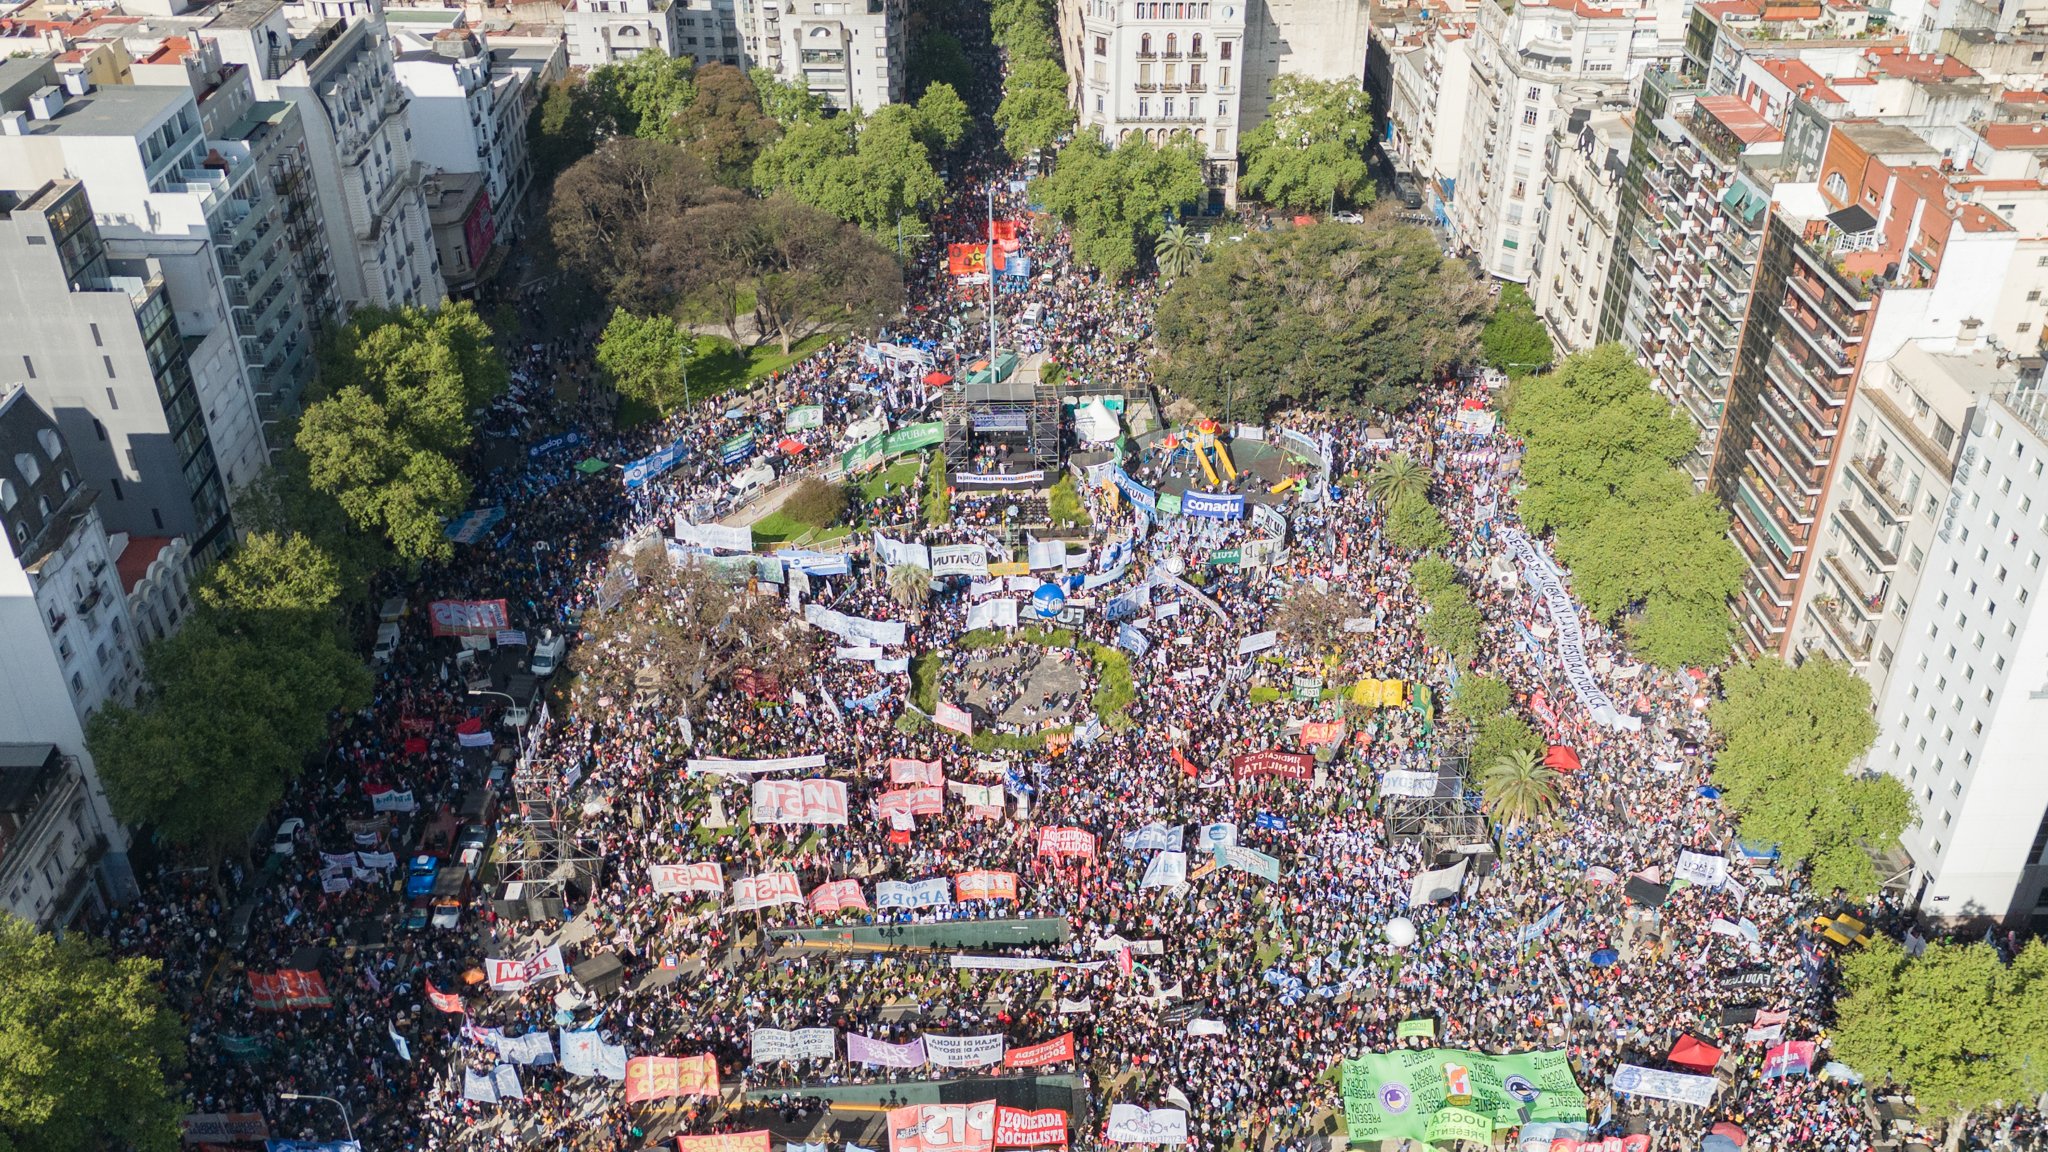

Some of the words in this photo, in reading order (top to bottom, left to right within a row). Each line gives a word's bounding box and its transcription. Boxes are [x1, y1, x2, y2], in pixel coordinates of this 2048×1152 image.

[897, 429, 926, 441] APUBA
[1187, 500, 1239, 513] conadu
[1401, 1050, 1436, 1067] PRESENTE
[1534, 1056, 1566, 1070] PRESENTE
[1411, 1065, 1435, 1080] UOCRA
[1472, 1062, 1496, 1073] UOCRA
[1410, 1072, 1443, 1092] PRESENTE
[1469, 1070, 1503, 1088] PRESENTE
[1540, 1069, 1565, 1083] UOCRA
[1346, 1078, 1369, 1089] UOCRA
[1343, 1086, 1376, 1099] PRESENTE
[1418, 1087, 1442, 1102] UOCRA
[1350, 1102, 1375, 1114] UOCRA
[1549, 1096, 1586, 1108] PRESENTE
[999, 1108, 1063, 1130] IZQUIERDA
[1347, 1112, 1382, 1125] PRESENTE
[997, 1126, 1066, 1145] SOCIALISTA
[1354, 1127, 1379, 1138] UOCRA
